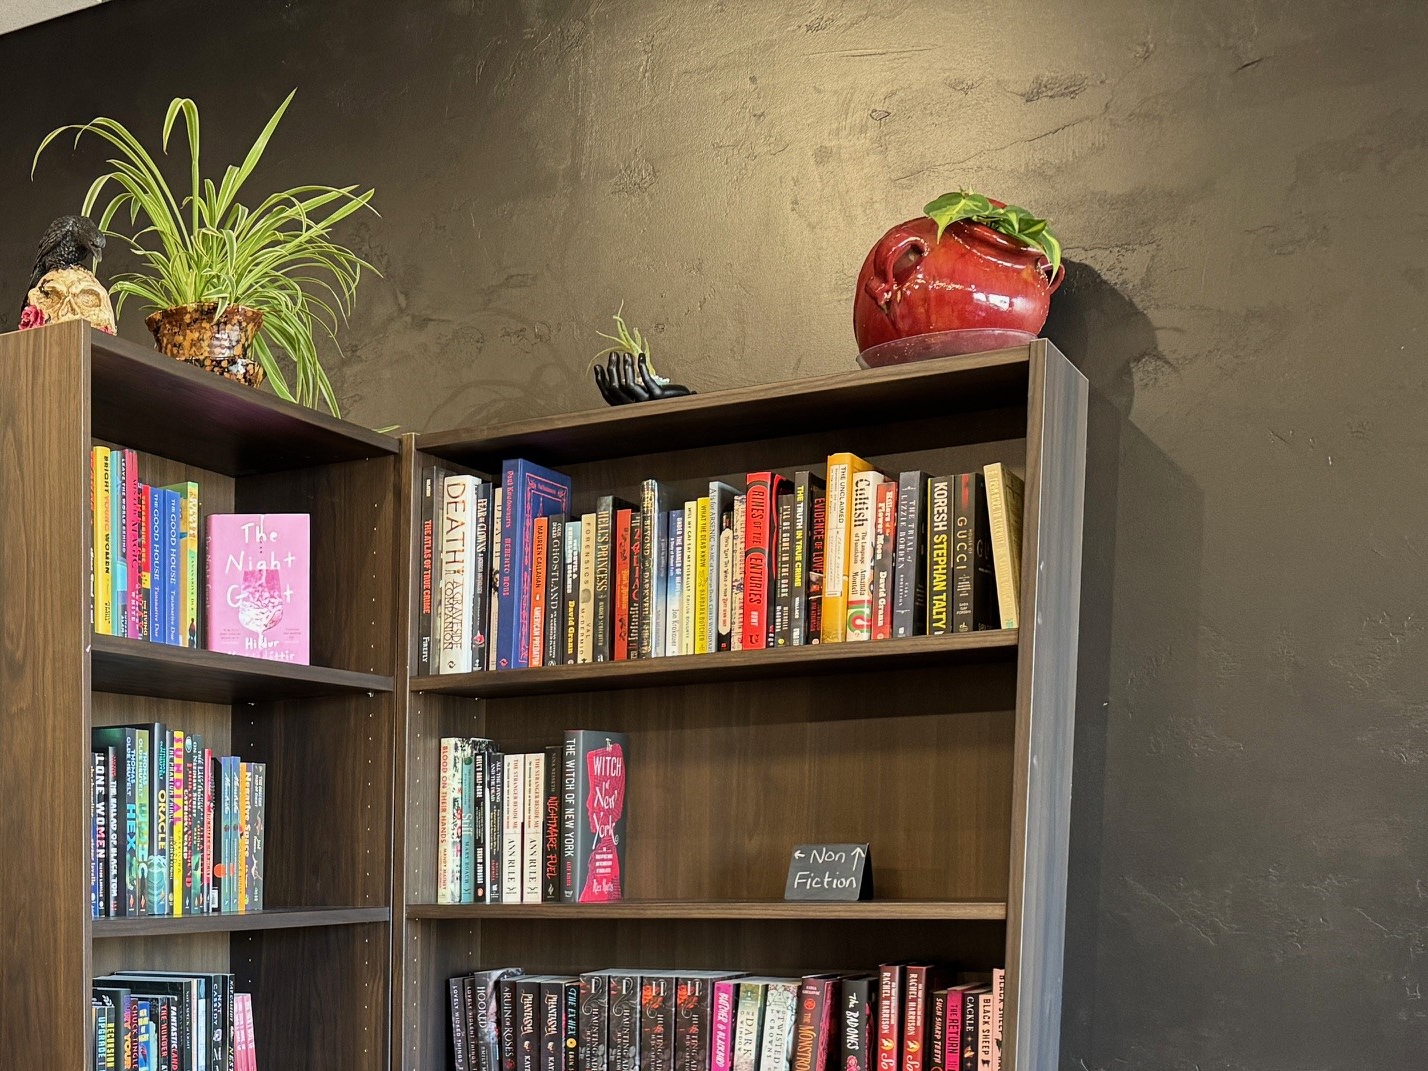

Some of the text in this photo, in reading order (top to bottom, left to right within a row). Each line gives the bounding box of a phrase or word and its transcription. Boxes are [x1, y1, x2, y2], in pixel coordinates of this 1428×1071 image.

[854, 479, 870, 528] Cultish
[241, 522, 278, 543] The
[446, 483, 466, 565] DEATH
[957, 517, 967, 569] GUCCI
[226, 553, 296, 575] Night
[795, 537, 803, 558] TRUE
[933, 482, 948, 628] KORESH STEPHAN TALTY
[173, 736, 184, 826] SUNDIAL
[442, 777, 447, 786] ON
[594, 756, 621, 777] WITCH
[565, 739, 575, 857] THE WITCH OF NEW YORK
[594, 787, 617, 809] New
[127, 804, 136, 851] HEX
[158, 790, 166, 850] ORACLE
[546, 796, 558, 879] NIGHTMARE FUEL
[810, 847, 846, 864] Non
[794, 871, 857, 889] Fiction
[882, 972, 891, 998] RACHEL
[881, 1000, 890, 1034] HARRISON
[981, 999, 991, 1056] BLACK SHEEP
